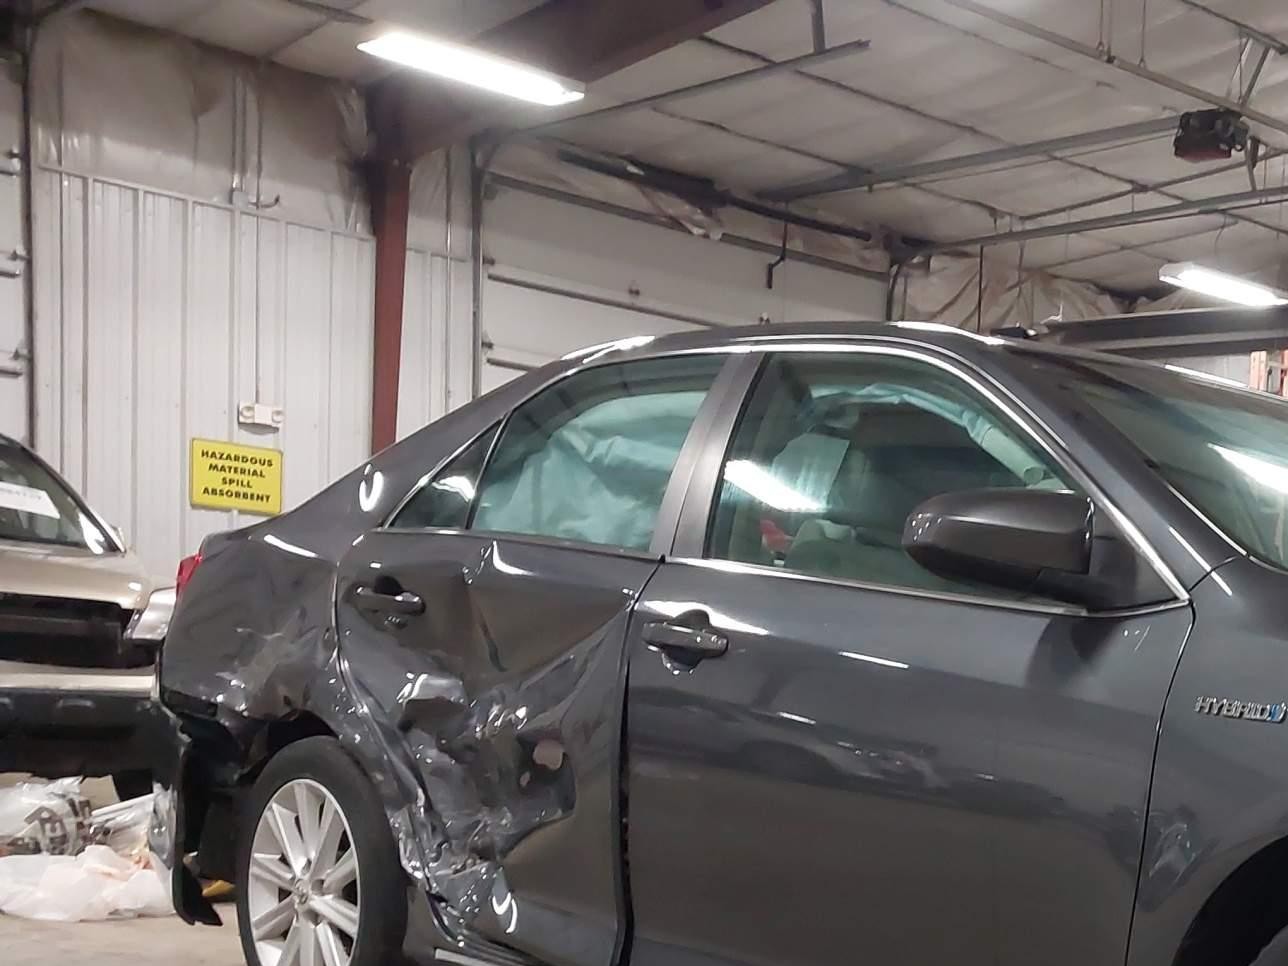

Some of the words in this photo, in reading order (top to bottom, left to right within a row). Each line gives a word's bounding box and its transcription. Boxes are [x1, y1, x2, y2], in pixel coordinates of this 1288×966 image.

[201, 449, 273, 467] HAZARDOUS
[208, 463, 266, 478] MATERIAL
[221, 477, 253, 488] SPILL
[202, 487, 271, 503] ABSORBENT
[1194, 696, 1271, 720] HYBRID
